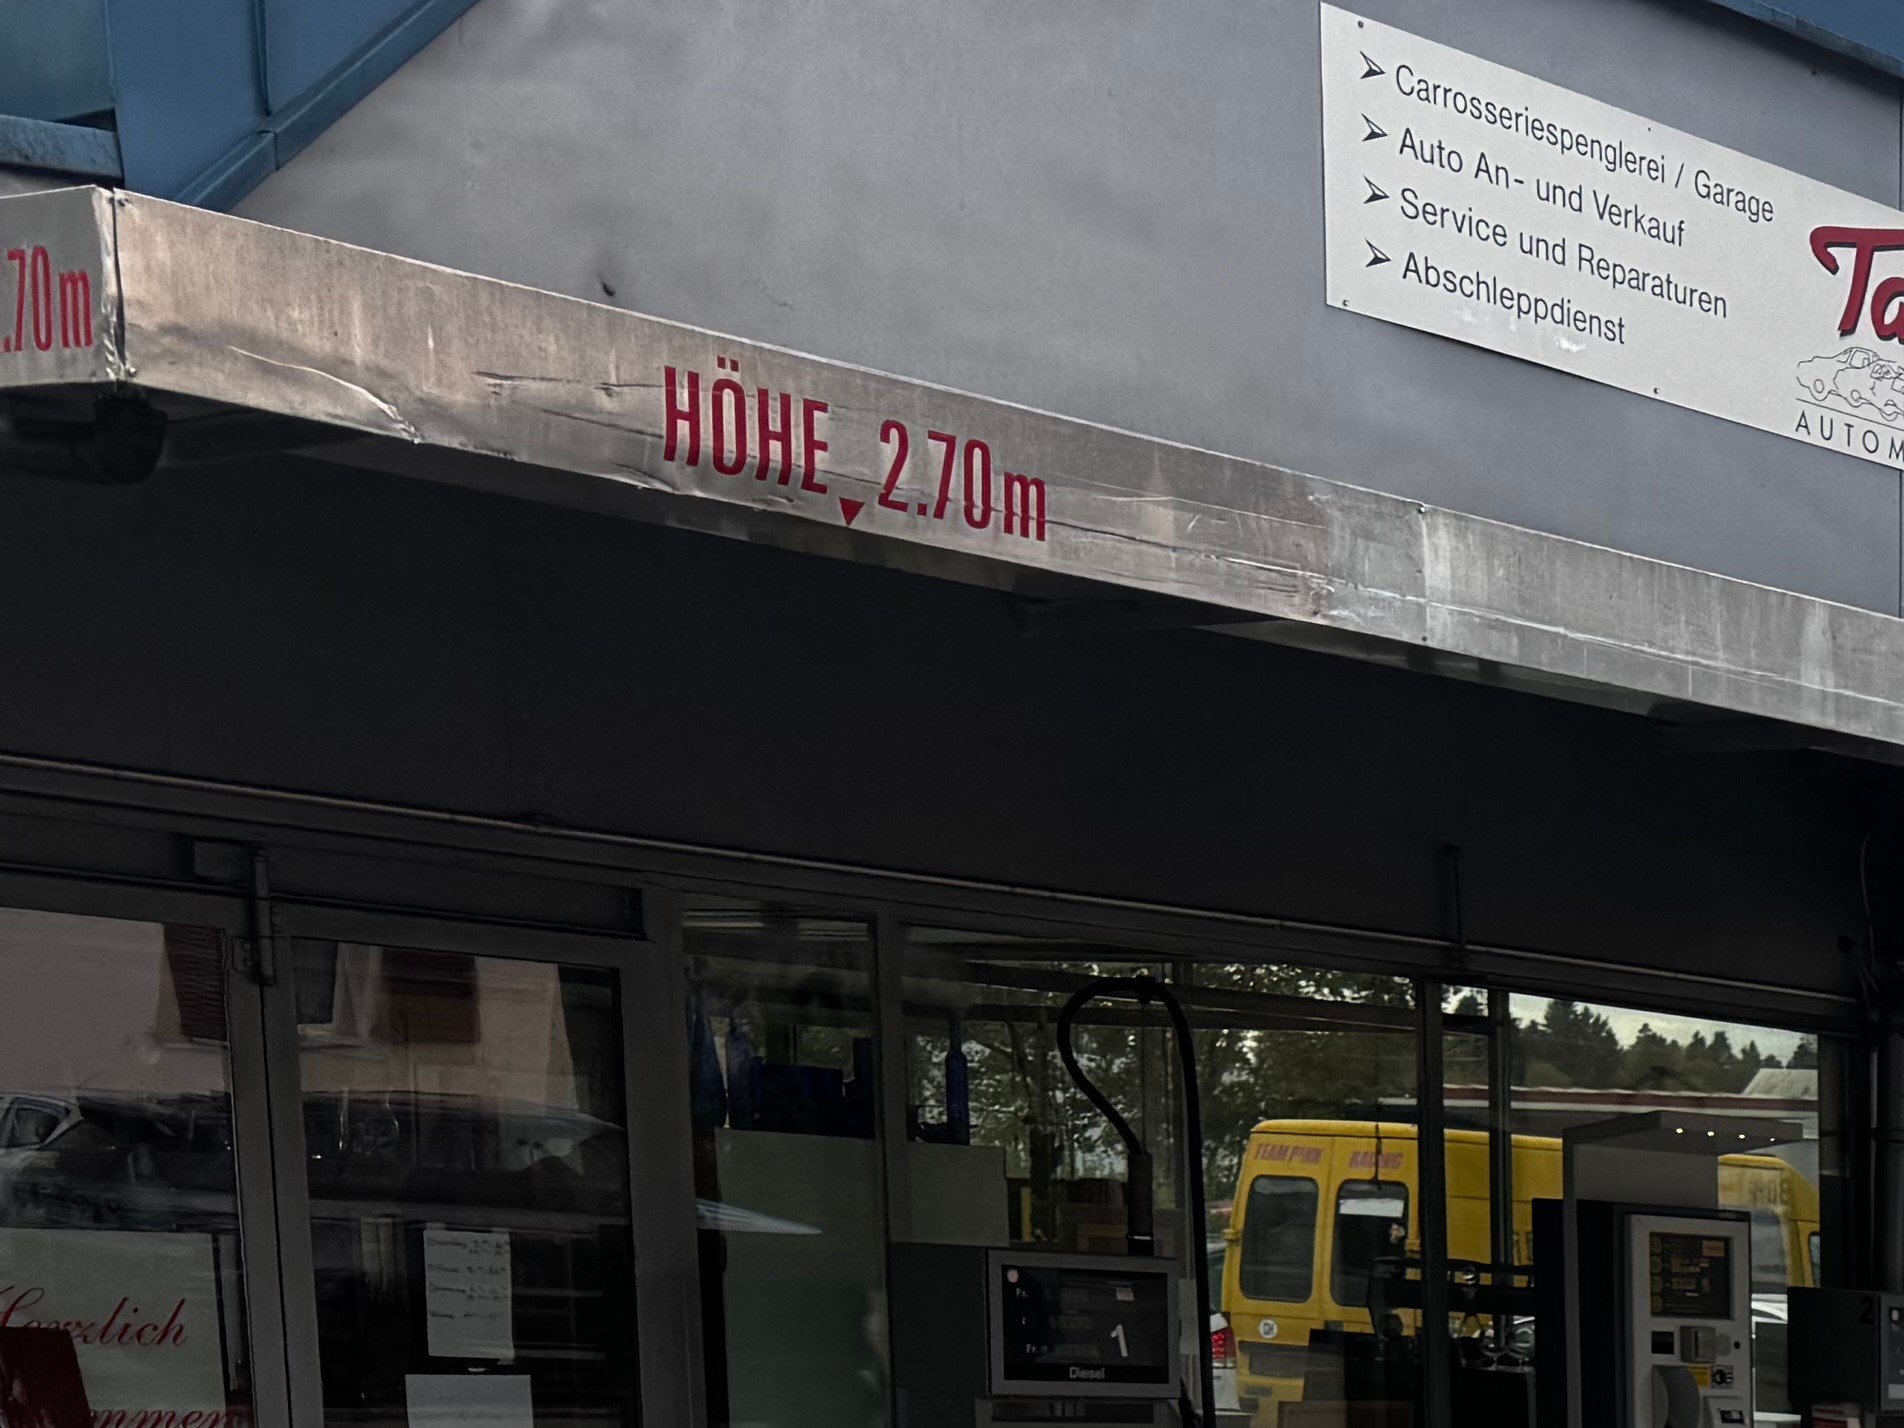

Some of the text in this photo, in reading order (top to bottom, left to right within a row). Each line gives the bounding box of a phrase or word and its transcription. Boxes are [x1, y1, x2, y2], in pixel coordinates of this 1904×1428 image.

[1395, 64, 1774, 223] Carrosseriespenglerei / Garage
[1399, 127, 1685, 247] Auto An- und Verkauf
[1400, 187, 1727, 319] Service und Reparaturen
[1402, 251, 1625, 345] Abschleppdienst
[663, 355, 829, 495] HÖHE
[1068, 1366, 1106, 1380] Diesel
[1110, 1324, 1128, 1358] 1
